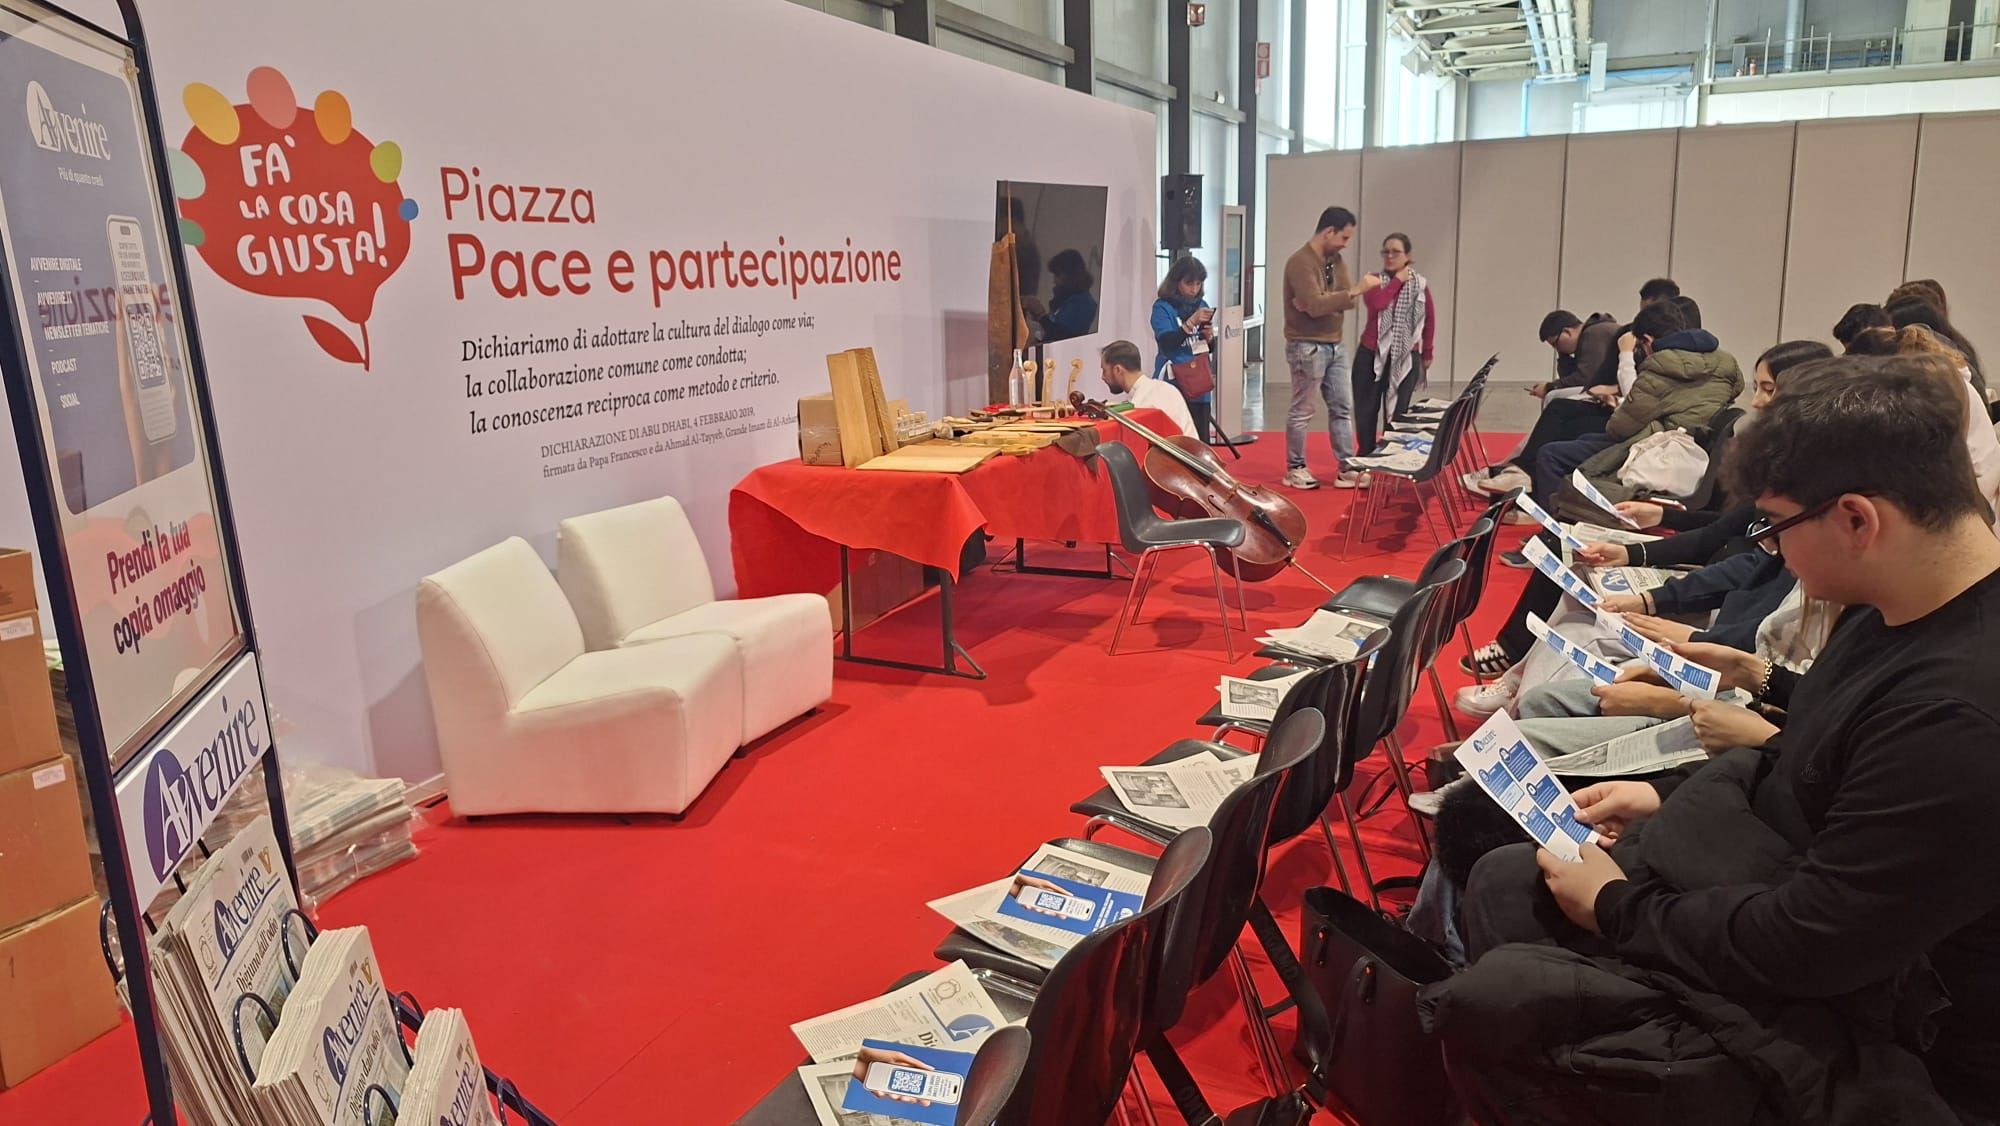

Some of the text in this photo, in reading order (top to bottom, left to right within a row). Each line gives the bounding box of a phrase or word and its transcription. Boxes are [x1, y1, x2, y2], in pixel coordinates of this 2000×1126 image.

[239, 191, 355, 226] LA COSA
[440, 167, 595, 224] Piazza
[30, 257, 83, 271] AVVENIRE DIGITALE
[236, 202, 388, 276] GIUSTA!
[447, 233, 901, 308] Pace e partecipazione
[44, 324, 82, 341] NEWSLETTER
[461, 312, 815, 362] Dichiariamo di adottare la cultura del dialogo come via;
[51, 358, 77, 375] PODCAST
[465, 346, 747, 398] la collaborazione comune come condotta;
[60, 392, 81, 408] SOCIAL
[470, 369, 779, 434] la conoscenza reciproca come metodo e criterio.
[541, 406, 755, 458] DICHIARAZIONE DI ABU DHABI, 4 FEBBRAIO 2019,
[543, 463, 575, 478] firmata
[577, 458, 587, 470] da
[589, 455, 609, 469] Papa
[610, 447, 648, 463] Francesco
[649, 445, 654, 454] e
[654, 441, 663, 452] da
[664, 436, 690, 450] Ahmad
[725, 423, 748, 438] Grande
[107, 519, 191, 594] Prendi la tua
[113, 559, 206, 655] copia omaggio
[143, 696, 260, 884] Avvenire
[236, 952, 261, 993] Digiuno
